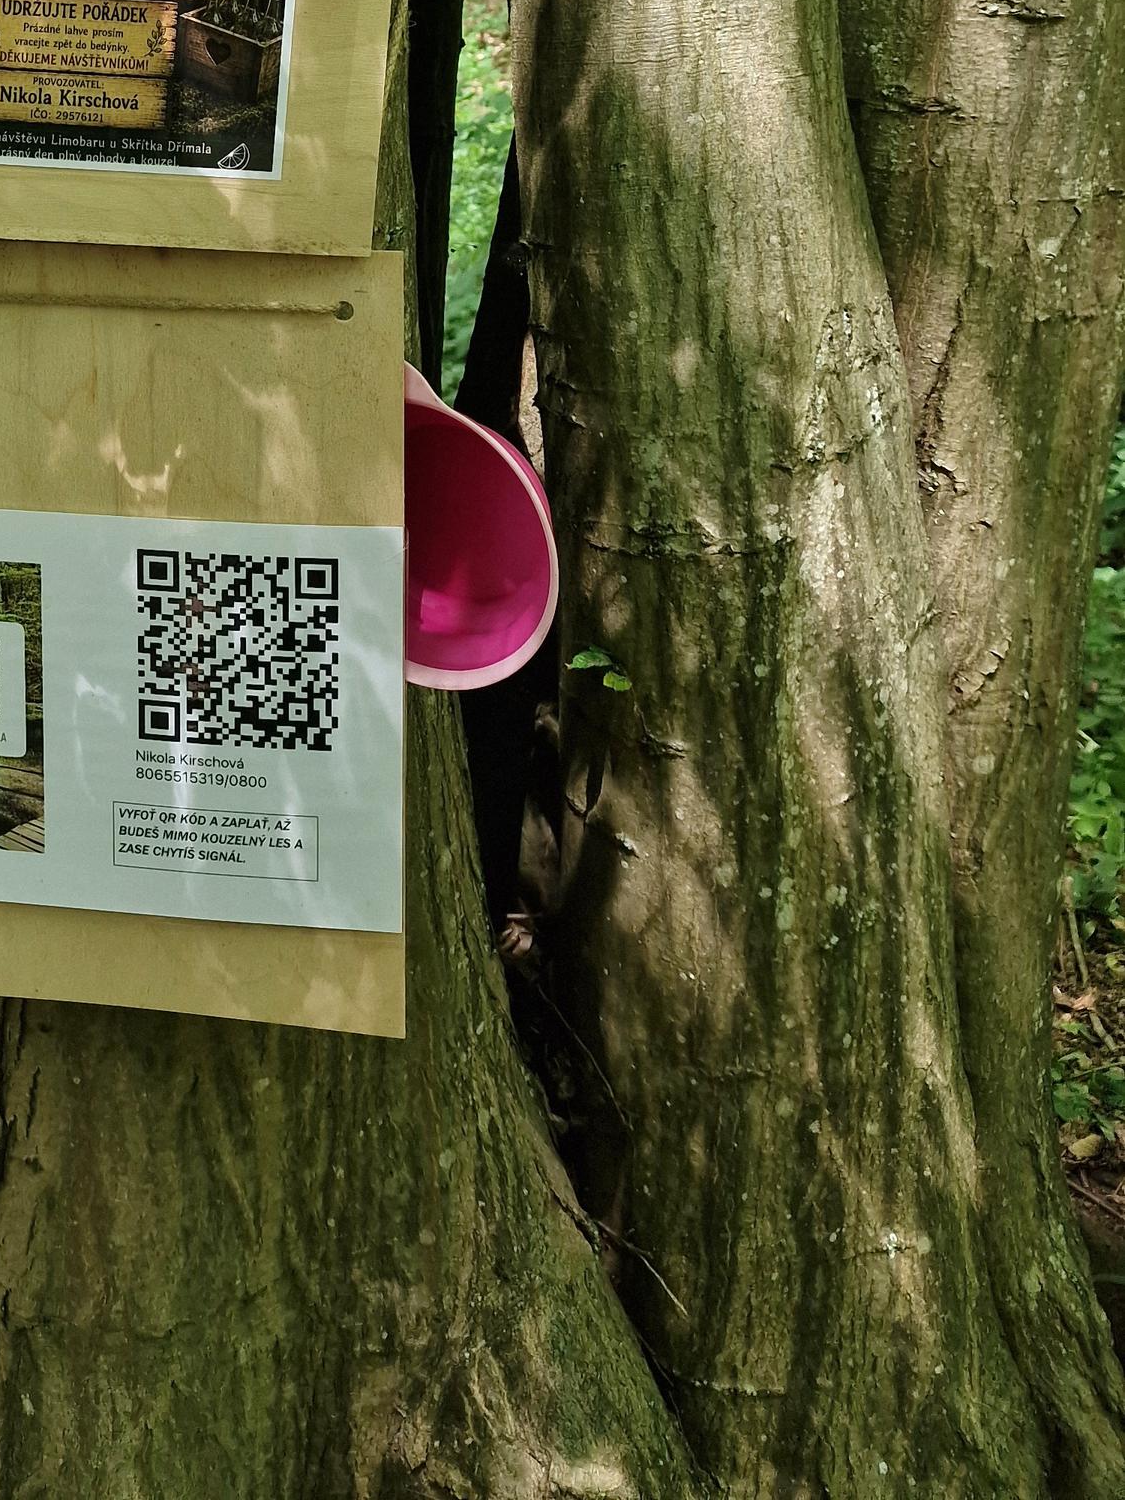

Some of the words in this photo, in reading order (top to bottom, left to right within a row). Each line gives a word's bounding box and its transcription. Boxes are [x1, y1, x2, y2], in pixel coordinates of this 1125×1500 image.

[82, 2, 148, 23] POŘÁDEK
[23, 23, 60, 34] Prázdné
[65, 24, 89, 36] lahve
[92, 27, 124, 39] prosím
[14, 37, 50, 50] vracejte
[53, 38, 72, 51] zpět
[75, 40, 87, 49] do
[91, 41, 130, 53] bedýnky.
[0, 49, 57, 65] DĚKUJEME
[33, 77, 105, 89] PROVOZOVATEL:
[0, 86, 52, 105] Nikola
[59, 89, 139, 110] Kirschová
[30, 107, 51, 119] IČO:
[56, 111, 104, 123] 29576121
[51, 134, 105, 148] Limobaru
[110, 140, 116, 149] u
[122, 138, 163, 151] Skřítka
[168, 141, 212, 154] Dřímala
[35, 148, 54, 159] den
[130, 157, 136, 165] a
[135, 750, 176, 764] Nikola
[180, 754, 245, 769] Kirschová
[136, 767, 267, 789] 8065515319/0800
[118, 808, 157, 821] VYFOŤ
[159, 812, 176, 824] QR
[180, 812, 207, 826] KÓD
[209, 816, 218, 826] A
[221, 817, 271, 832] ZAPLAŤ,
[274, 819, 291, 831] AŽ
[119, 825, 159, 839] BUDEŠ
[162, 829, 198, 842] MIMO
[201, 833, 267, 847] KOUZELNÝ
[269, 838, 291, 849] LES
[294, 839, 303, 849] A
[118, 842, 150, 855] ZASE
[153, 846, 195, 859] CHYTÍŠ
[198, 850, 246, 864] SIGNÁL.
